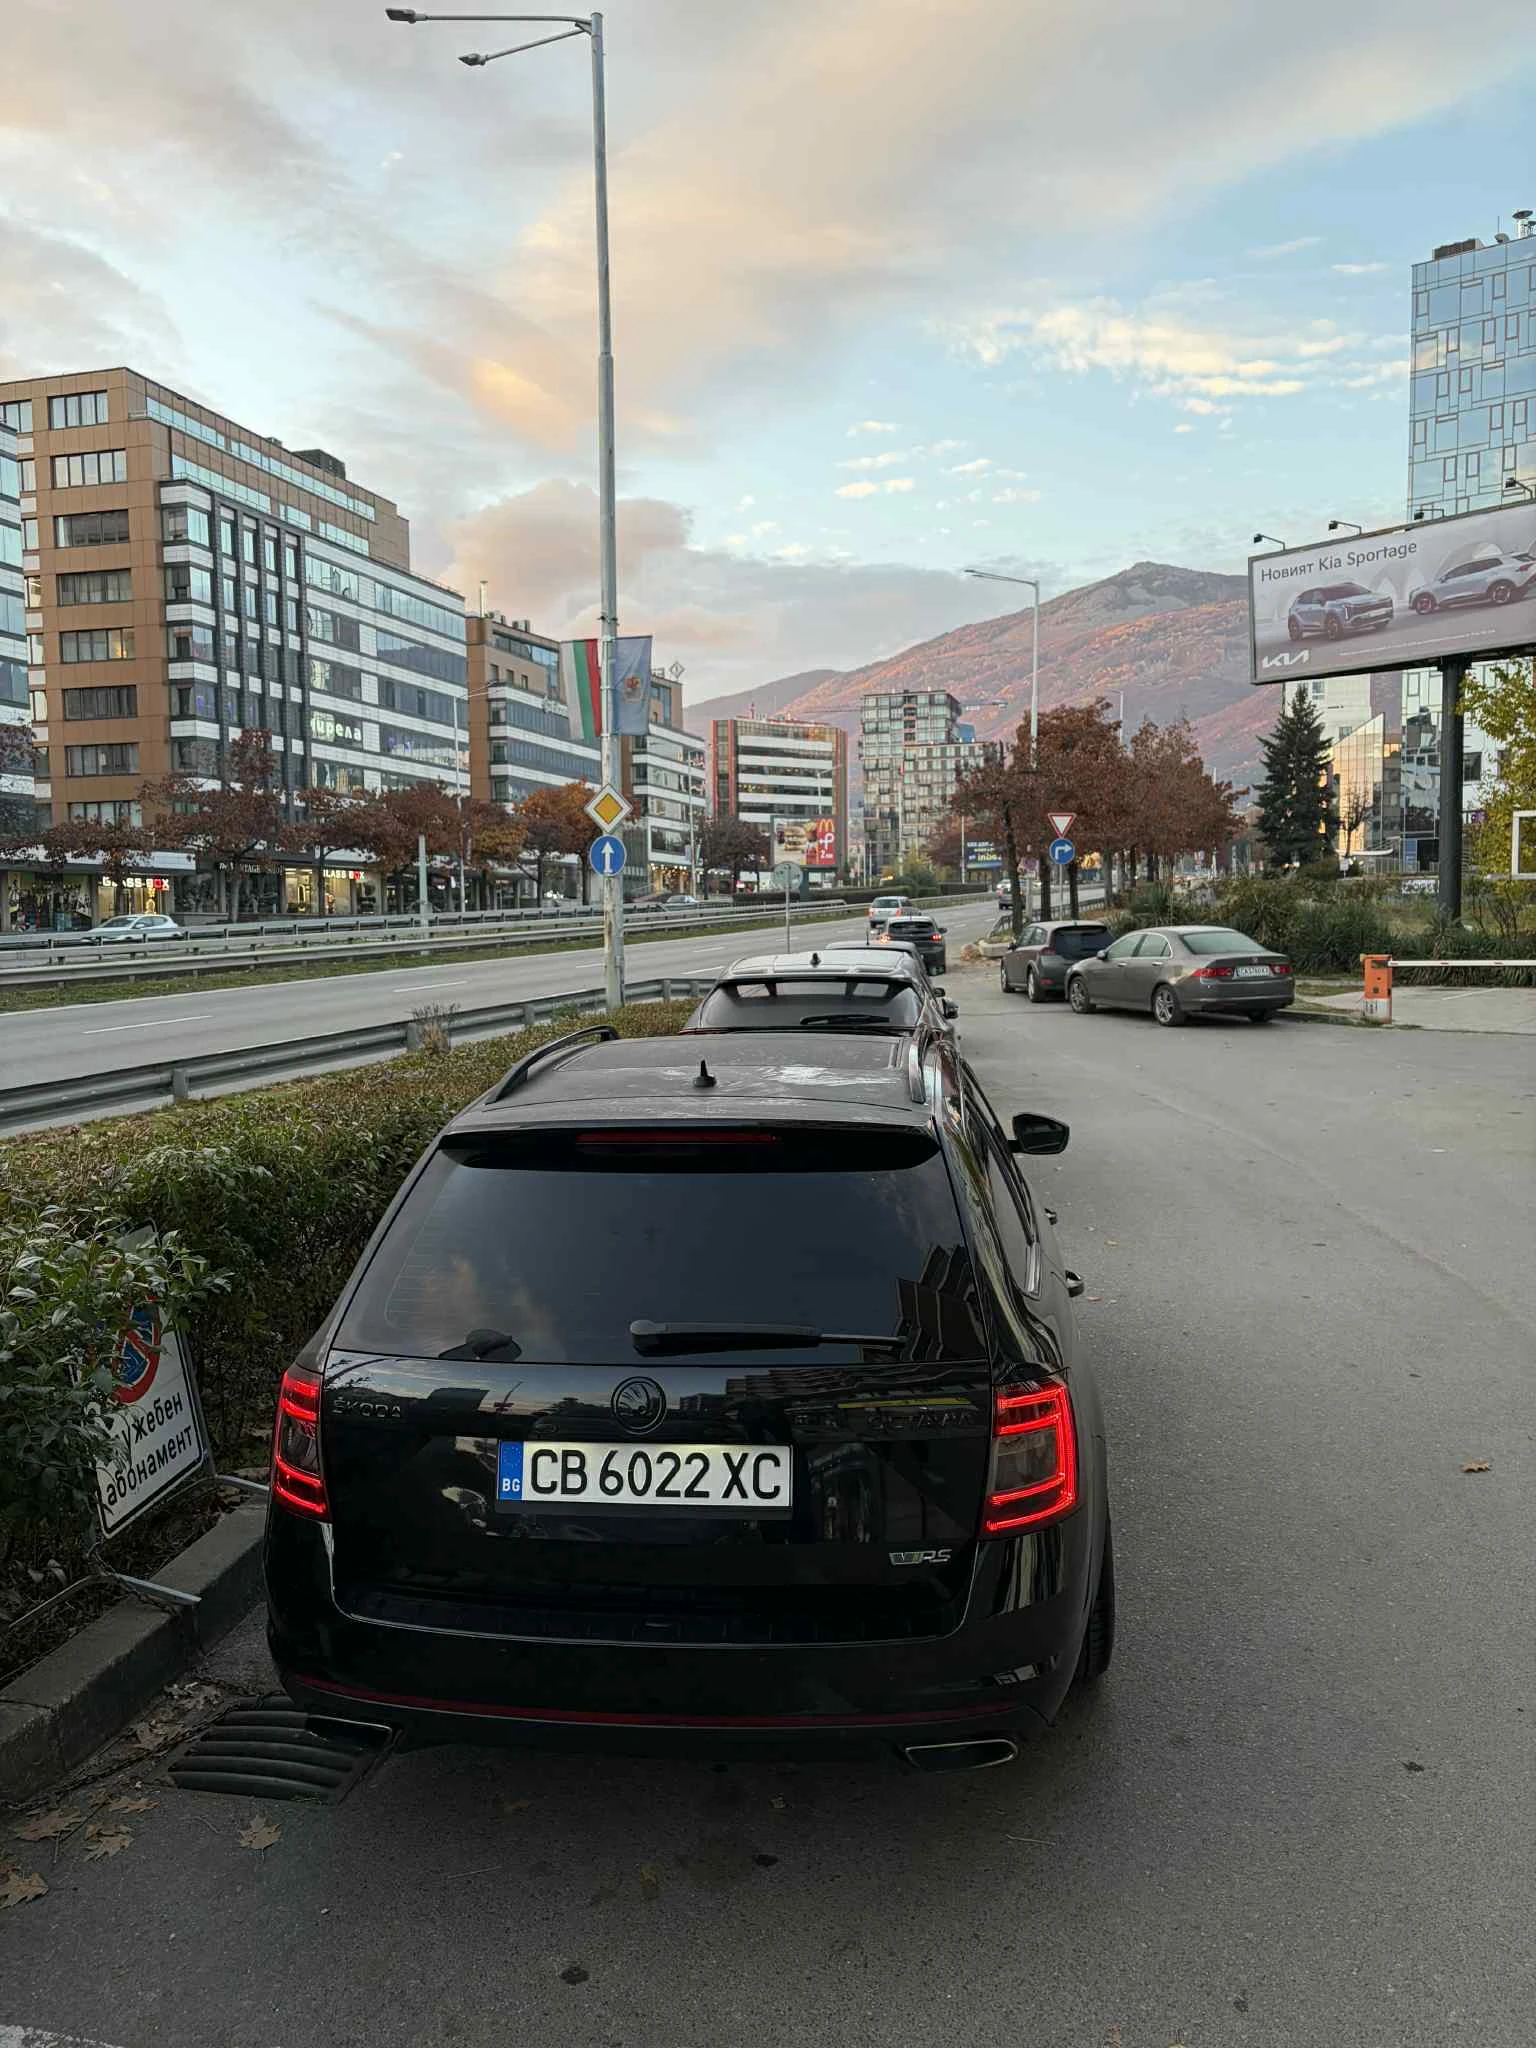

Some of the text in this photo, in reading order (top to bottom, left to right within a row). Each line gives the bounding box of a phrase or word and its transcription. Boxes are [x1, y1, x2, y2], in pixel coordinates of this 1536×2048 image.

[1260, 542, 1417, 583] Новият Kia Sportage
[146, 878, 169, 891] BOX
[107, 1425, 192, 1506] абонамент
[501, 1478, 521, 1491] BG
[530, 1449, 781, 1500] CB 6022 XC
